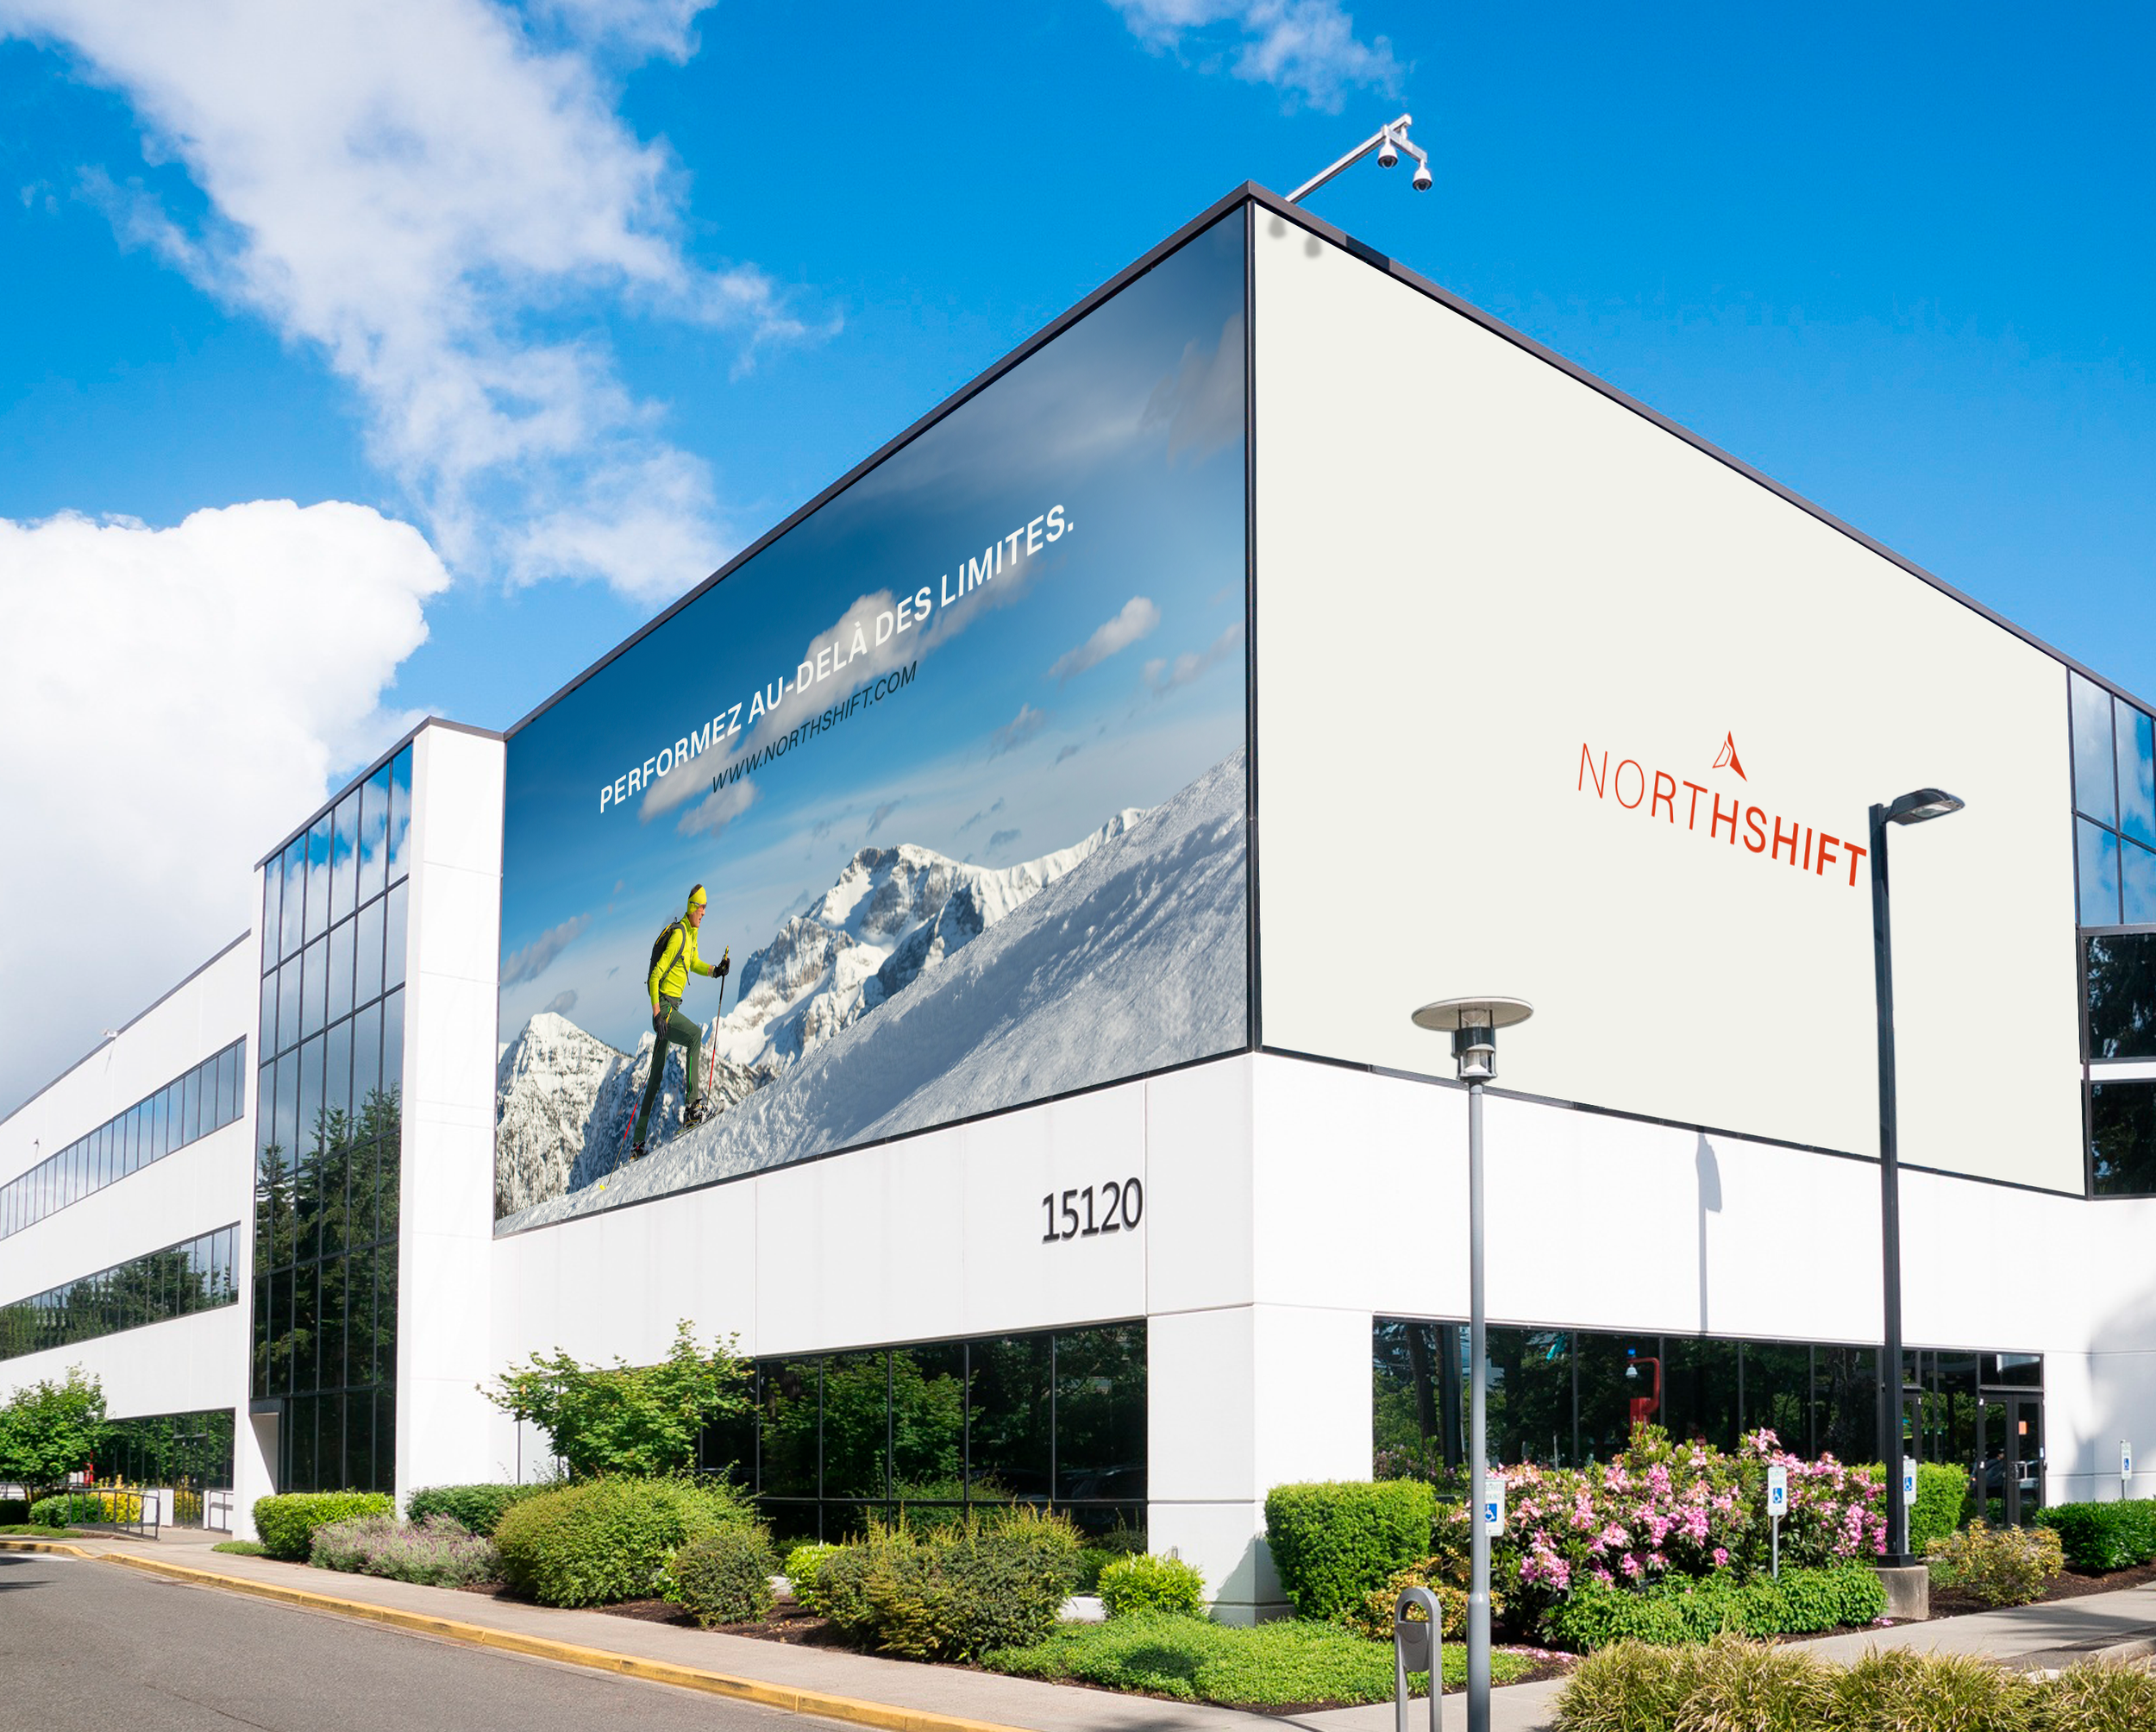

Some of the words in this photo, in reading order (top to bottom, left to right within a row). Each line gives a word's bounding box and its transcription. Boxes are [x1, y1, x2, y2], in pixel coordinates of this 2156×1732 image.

[599, 700, 742, 813] PERFORMEZ
[748, 621, 867, 723] AU-DELÀ
[875, 586, 931, 646] DES
[940, 504, 1074, 608] LIMITES.
[711, 660, 918, 794] WWW.NORTHSHIFT.COM
[1577, 742, 1867, 888] NORTHSHIFT
[1042, 1177, 1143, 1242] 15120
